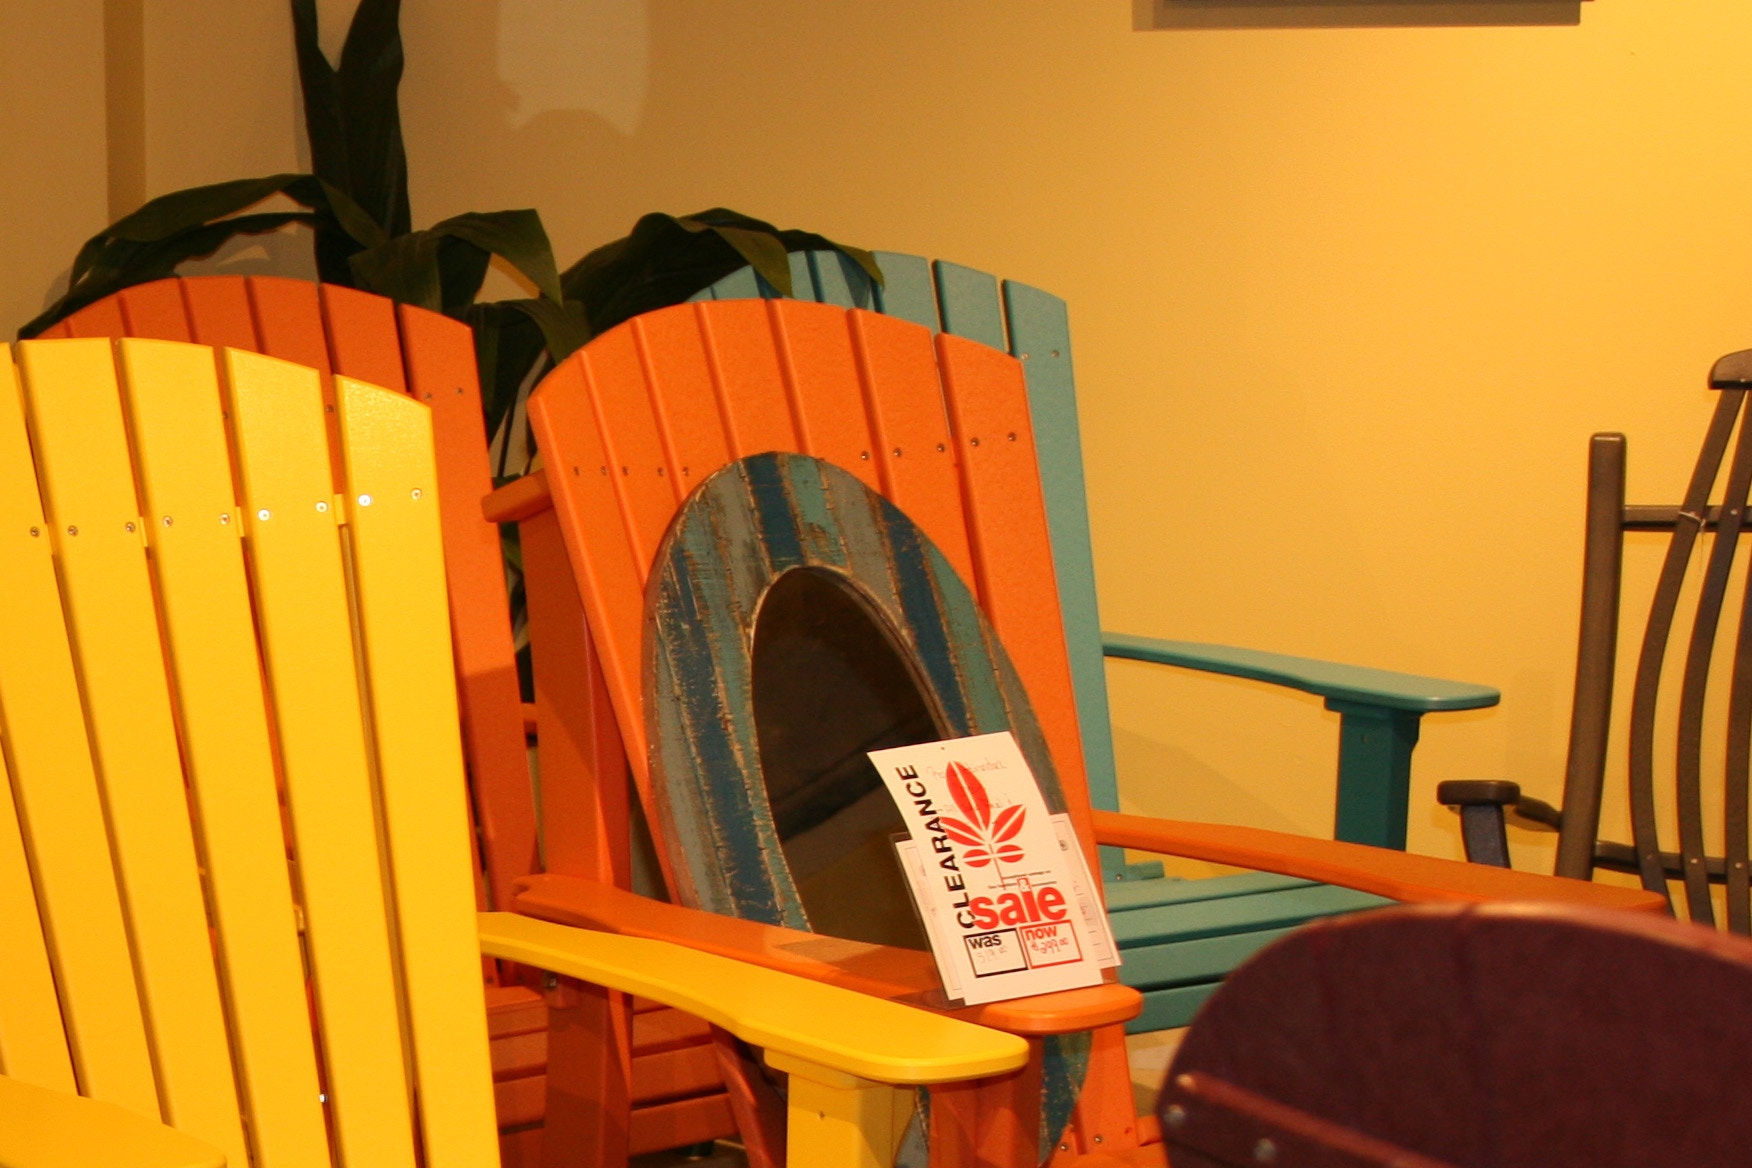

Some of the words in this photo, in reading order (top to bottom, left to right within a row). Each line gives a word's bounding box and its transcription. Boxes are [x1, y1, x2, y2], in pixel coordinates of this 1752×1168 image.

[895, 764, 976, 929] CLEARANCE
[969, 879, 1068, 930] sale
[968, 934, 1002, 949] was
[1025, 925, 1057, 941] now
